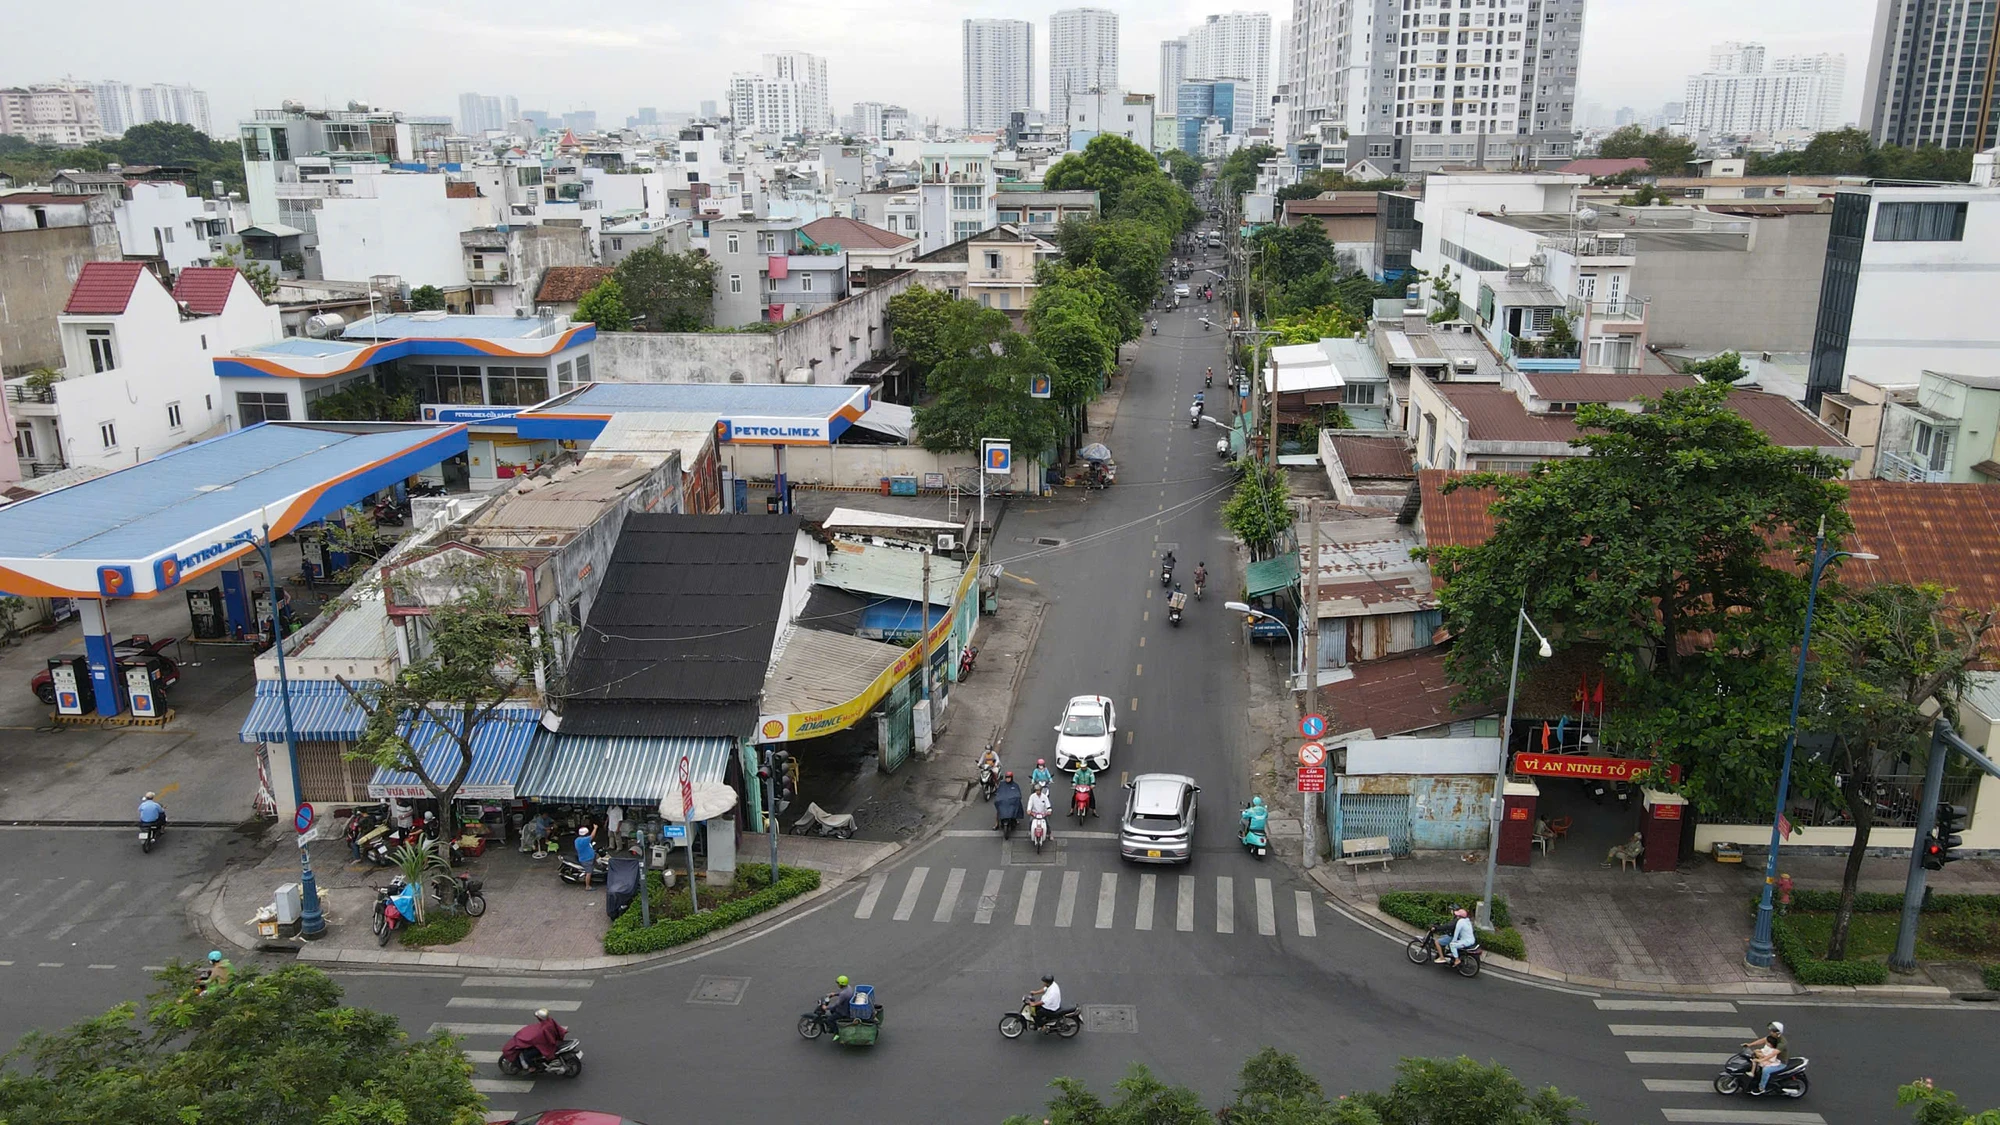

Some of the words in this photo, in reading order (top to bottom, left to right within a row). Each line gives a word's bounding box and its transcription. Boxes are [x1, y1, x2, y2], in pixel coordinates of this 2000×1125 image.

[734, 426, 820, 437] PETROLIMEX
[796, 714, 843, 732] ADVANCE
[804, 714, 823, 722] Shell
[1523, 759, 1539, 770] VÌ
[1542, 762, 1563, 771] AN
[1566, 763, 1603, 774] NINH
[1607, 761, 1626, 776] TỔ
